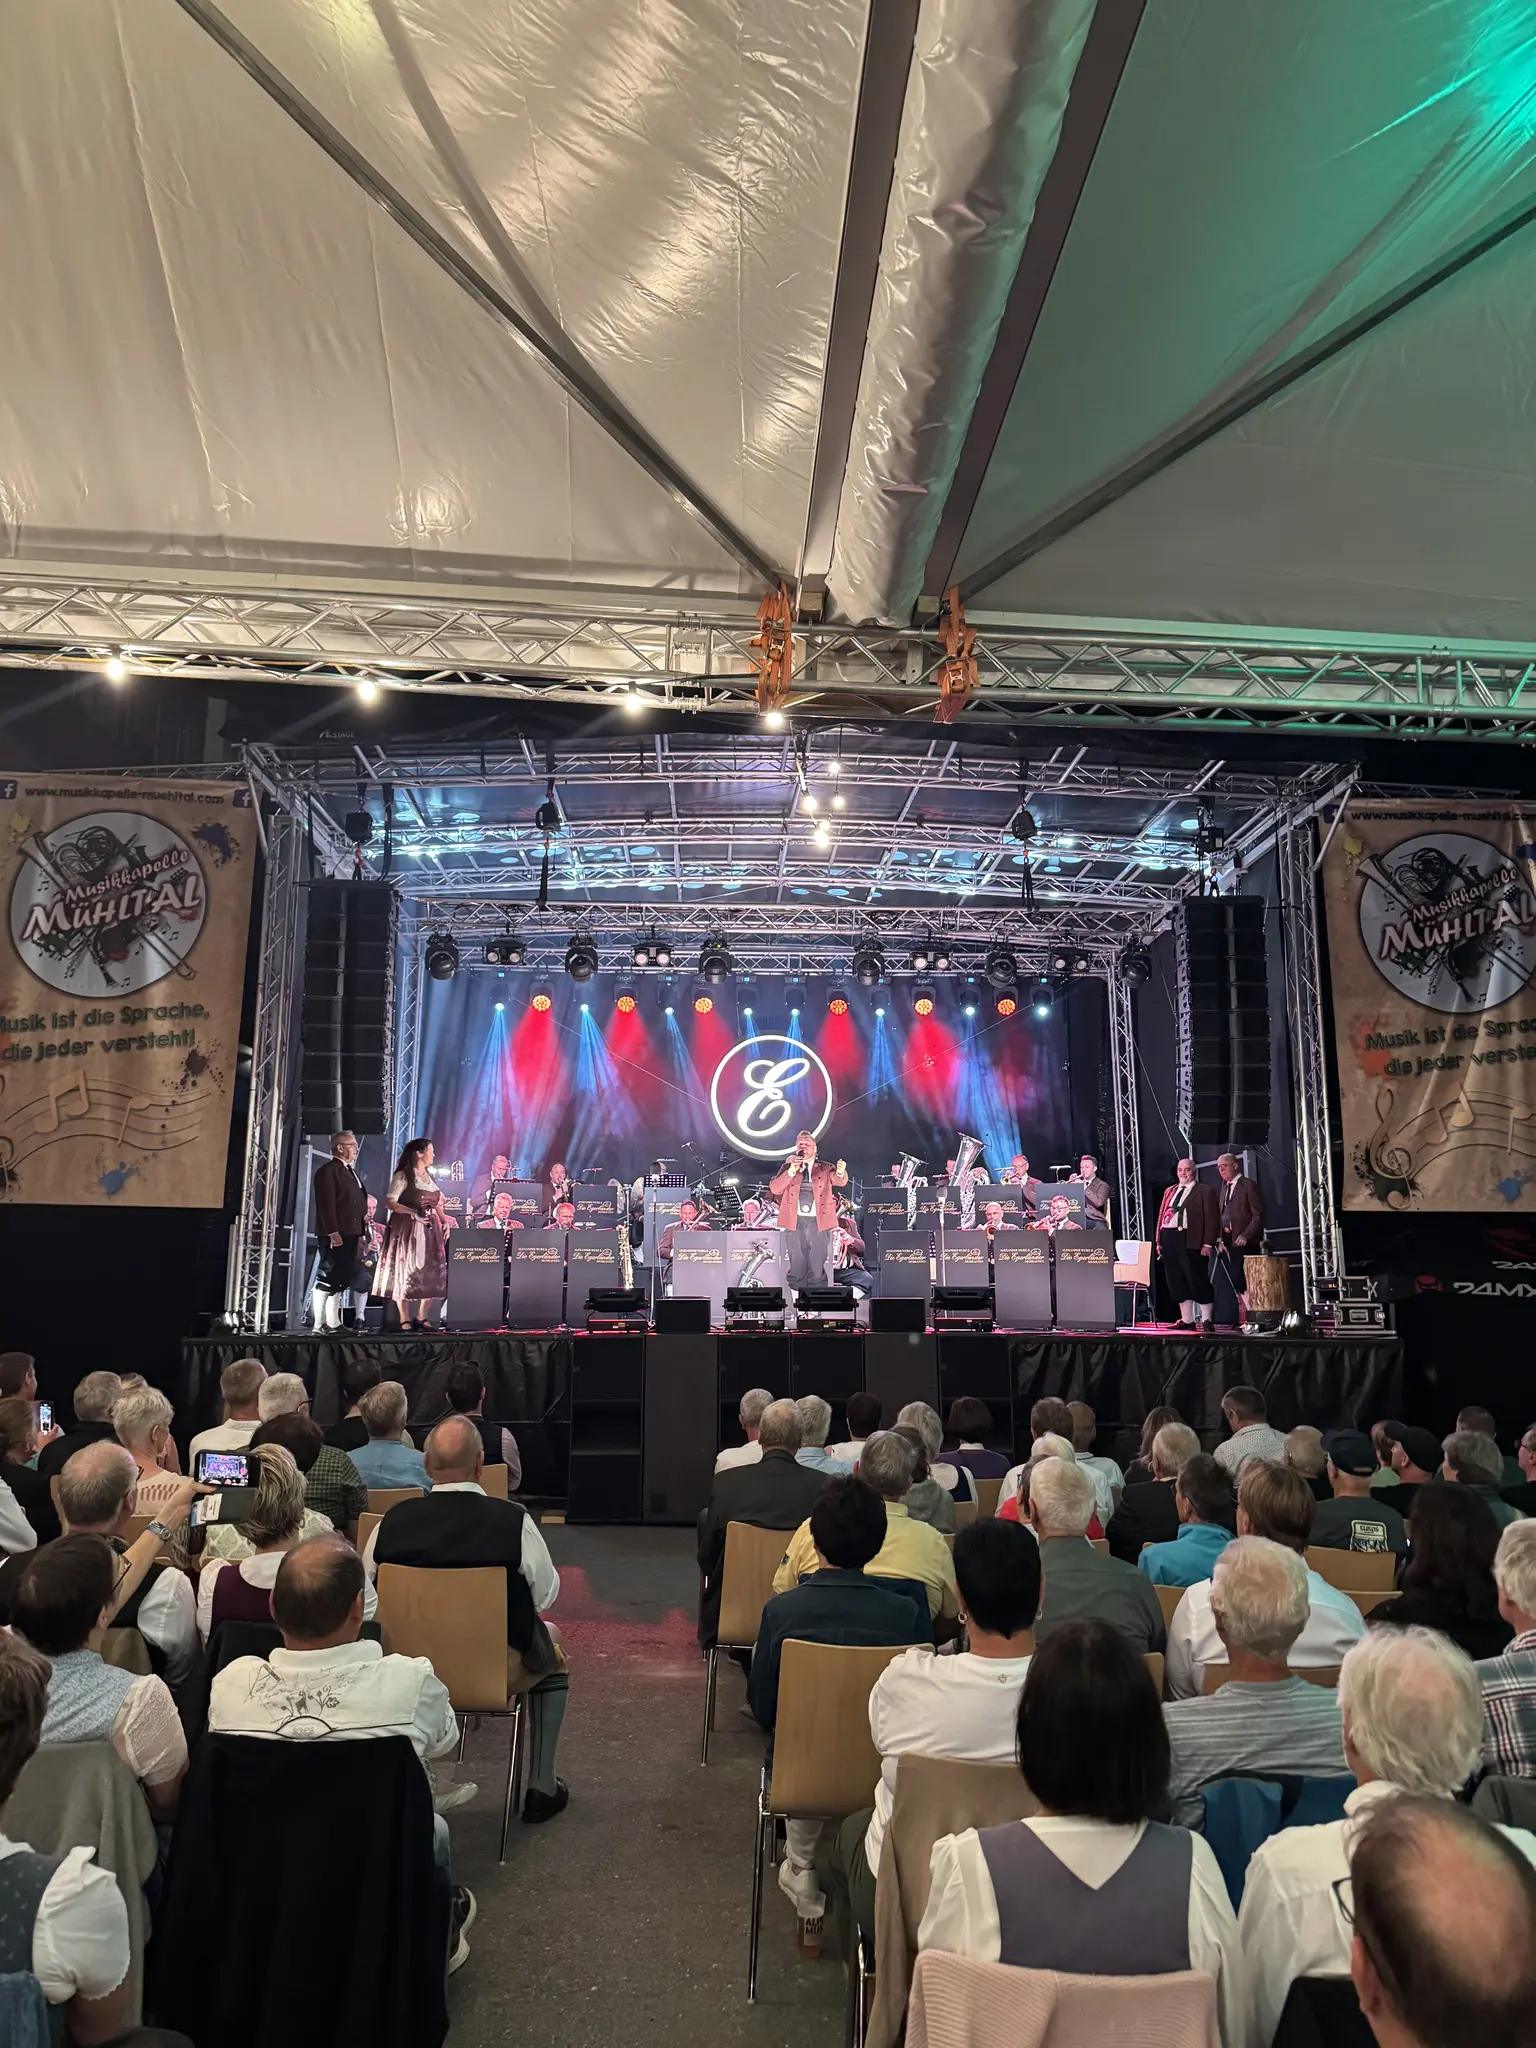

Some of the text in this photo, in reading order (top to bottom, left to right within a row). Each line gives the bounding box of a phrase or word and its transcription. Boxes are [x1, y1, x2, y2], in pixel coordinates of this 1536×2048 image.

[65, 851, 189, 905] Musikkapelle
[1412, 868, 1517, 924] Musikkapelle
[52, 1010, 78, 1030] ist
[83, 1007, 115, 1028] die
[120, 1001, 210, 1026] Sprache,
[3, 1029, 196, 1063] die jeder versteht!
[1366, 1029, 1421, 1050] Musik
[1423, 1025, 1446, 1045] ist
[1453, 1023, 1479, 1042] die
[1384, 1058, 1413, 1076] die
[1415, 1053, 1464, 1076] jeder
